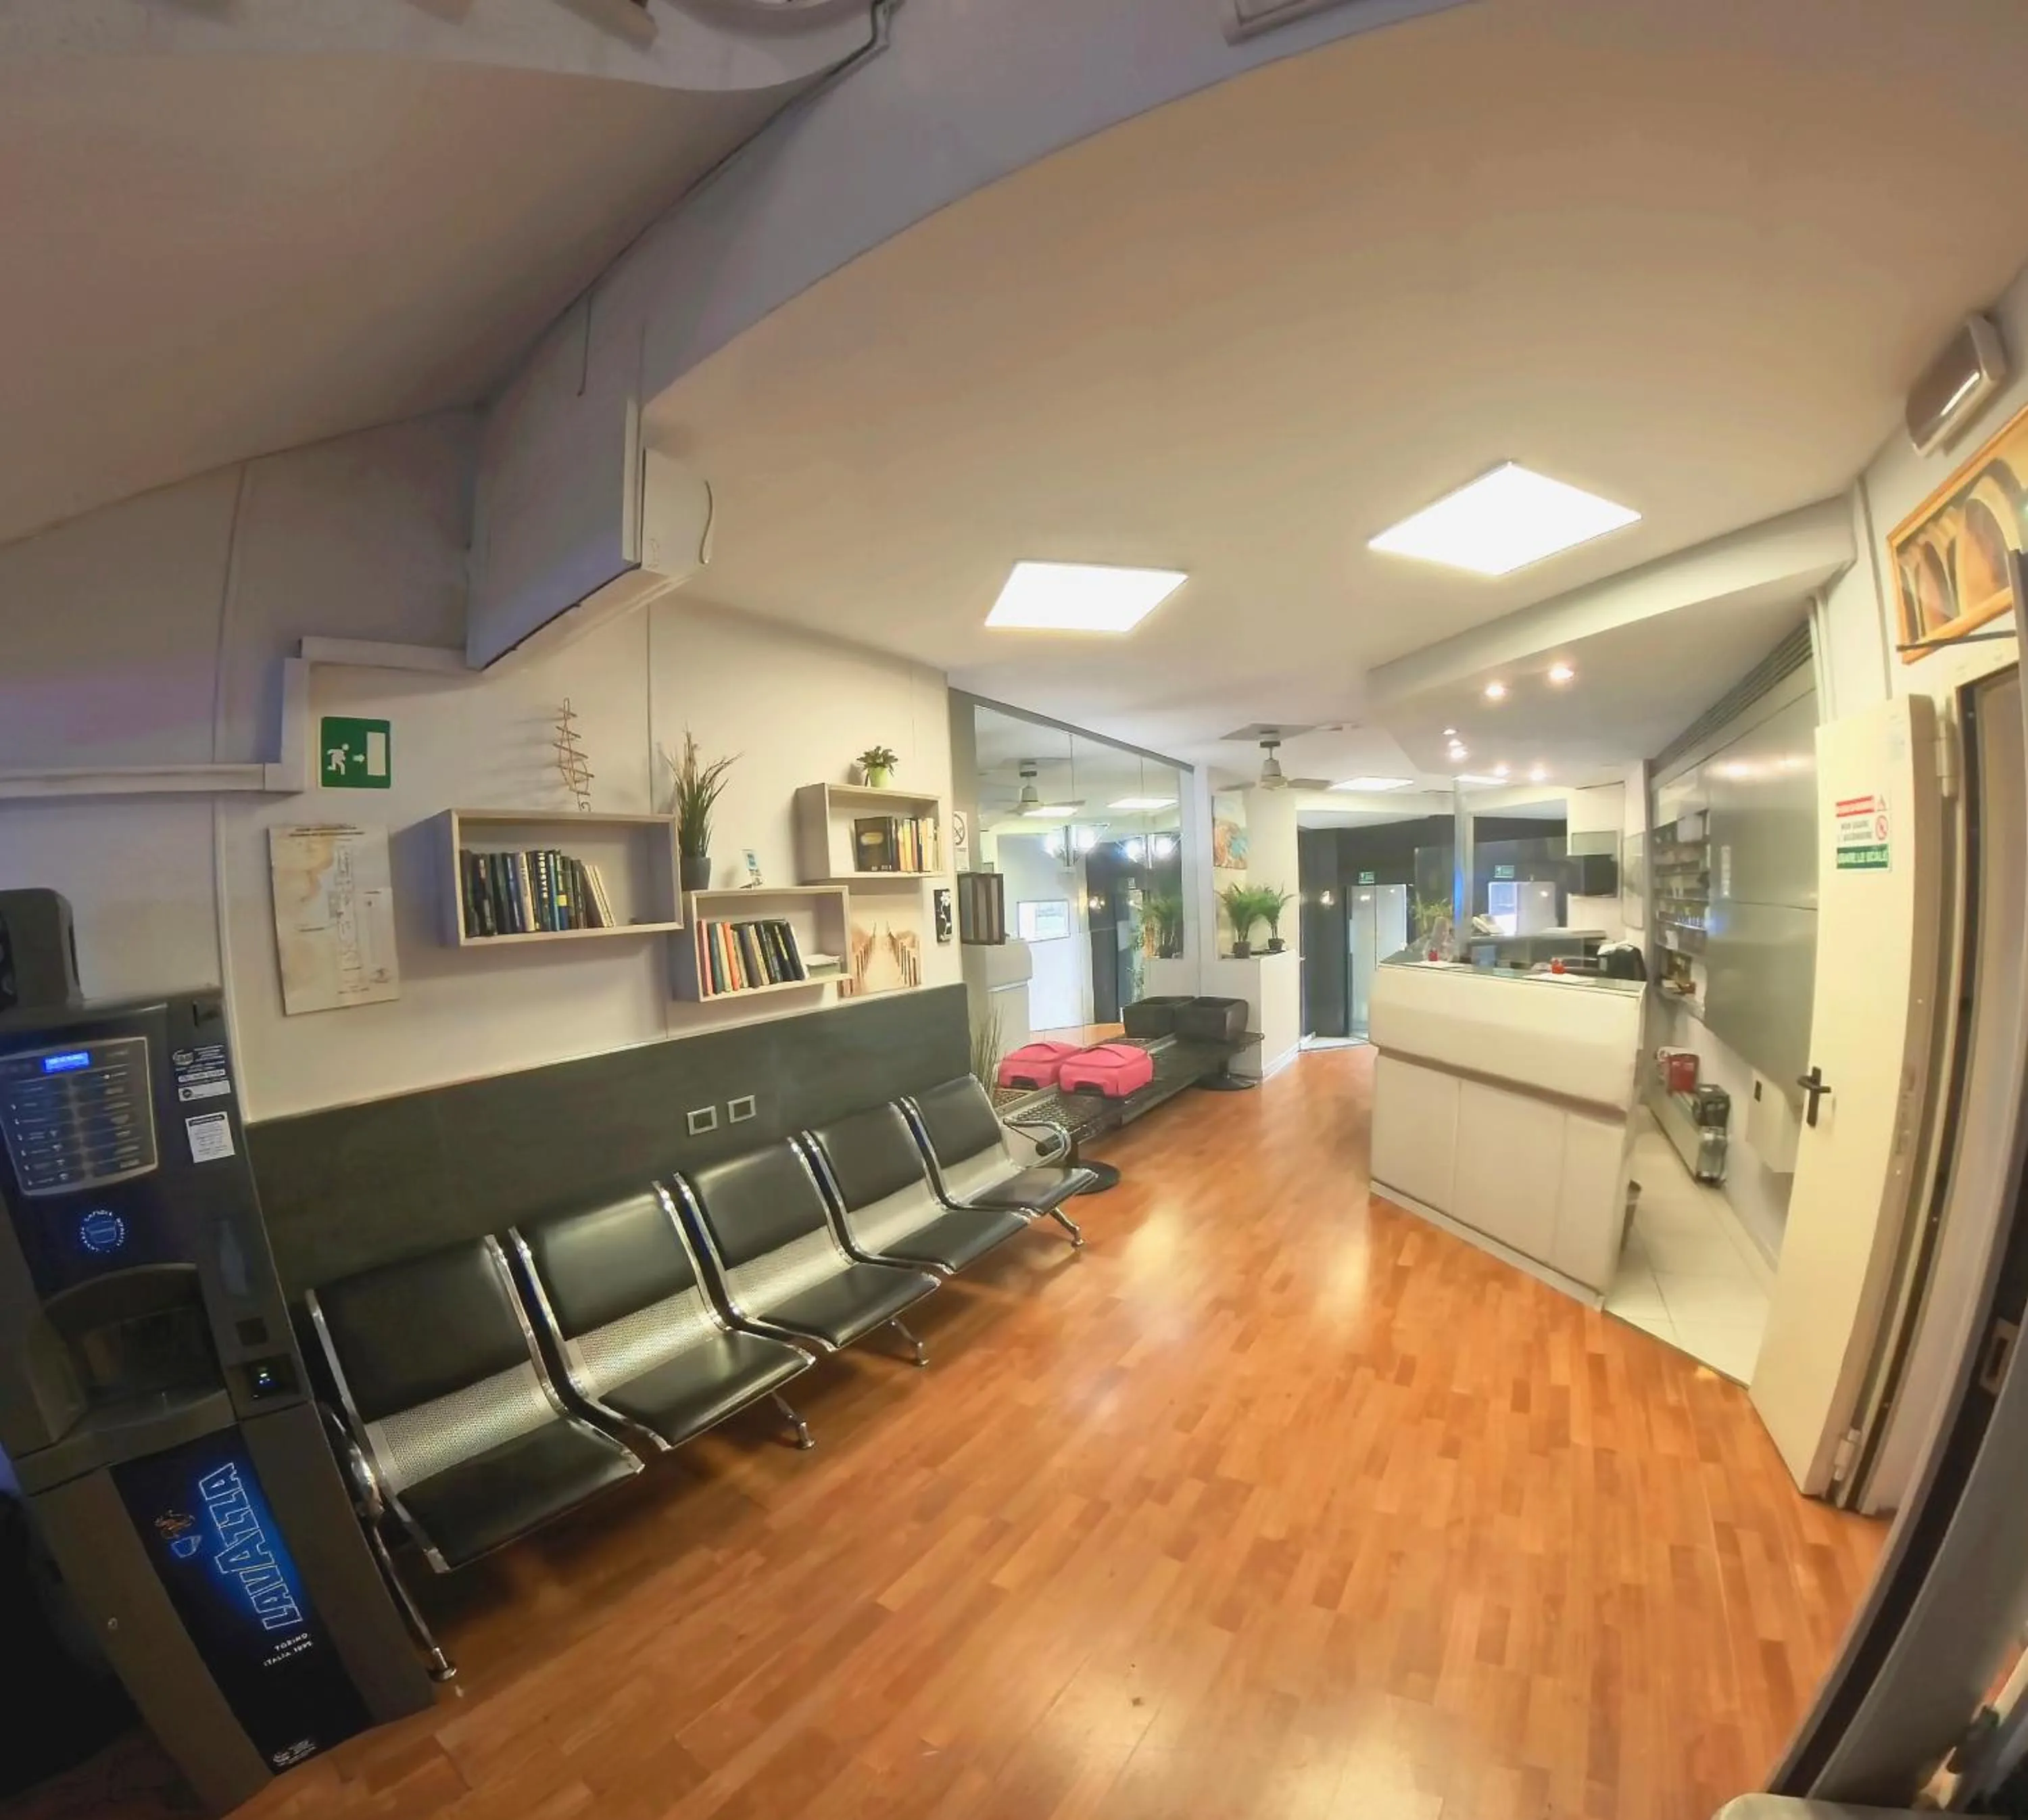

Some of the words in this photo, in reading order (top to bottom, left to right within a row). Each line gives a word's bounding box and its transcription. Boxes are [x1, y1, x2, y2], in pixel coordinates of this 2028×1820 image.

[199, 1462, 304, 1630] LAVAZZA
[274, 1633, 308, 1651] TORINO
[263, 1652, 291, 1667] ITALIA
